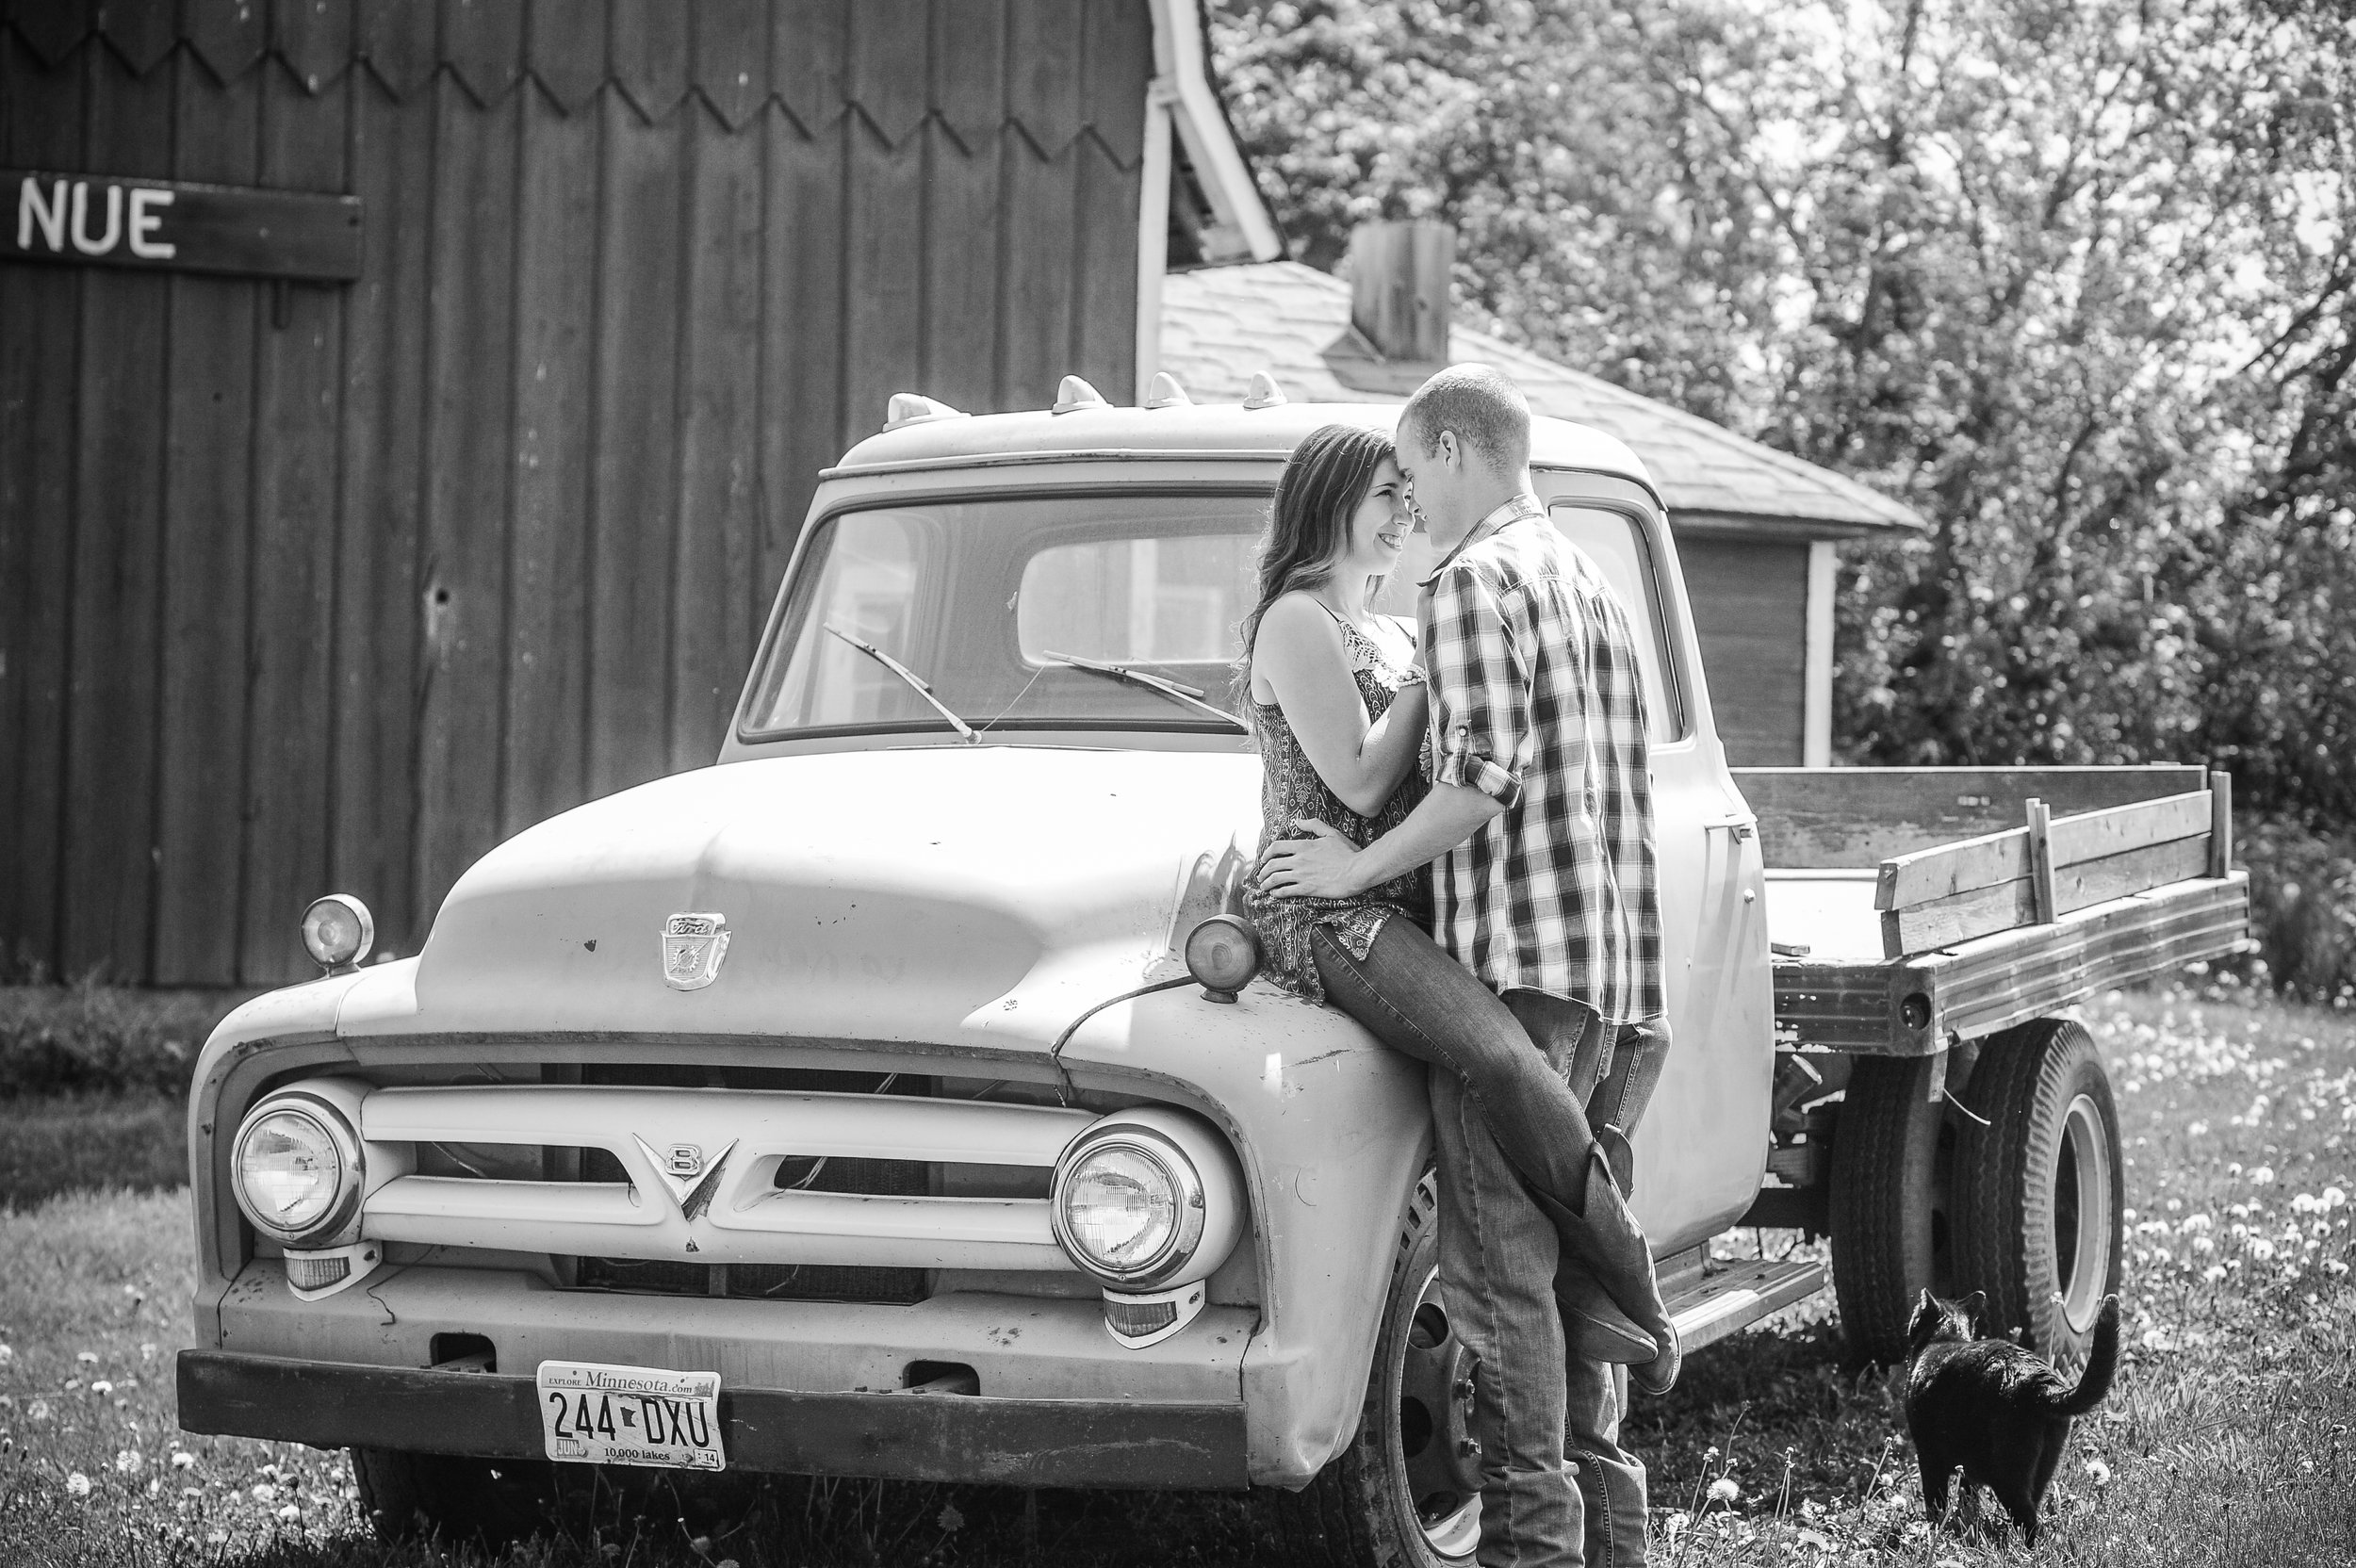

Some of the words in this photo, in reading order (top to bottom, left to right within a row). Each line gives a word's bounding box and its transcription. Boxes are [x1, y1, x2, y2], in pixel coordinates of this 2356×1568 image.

[17, 176, 177, 259] NUE
[670, 918, 710, 935] Ford
[548, 1377, 582, 1386] EXPLORE
[585, 1370, 693, 1395] Minnesota.com
[548, 1391, 616, 1442] 244
[640, 1398, 710, 1448] DXU
[557, 1440, 578, 1455] JUN
[604, 1447, 639, 1459] 10,000
[642, 1449, 671, 1461] lakes
[705, 1453, 715, 1462] 14
